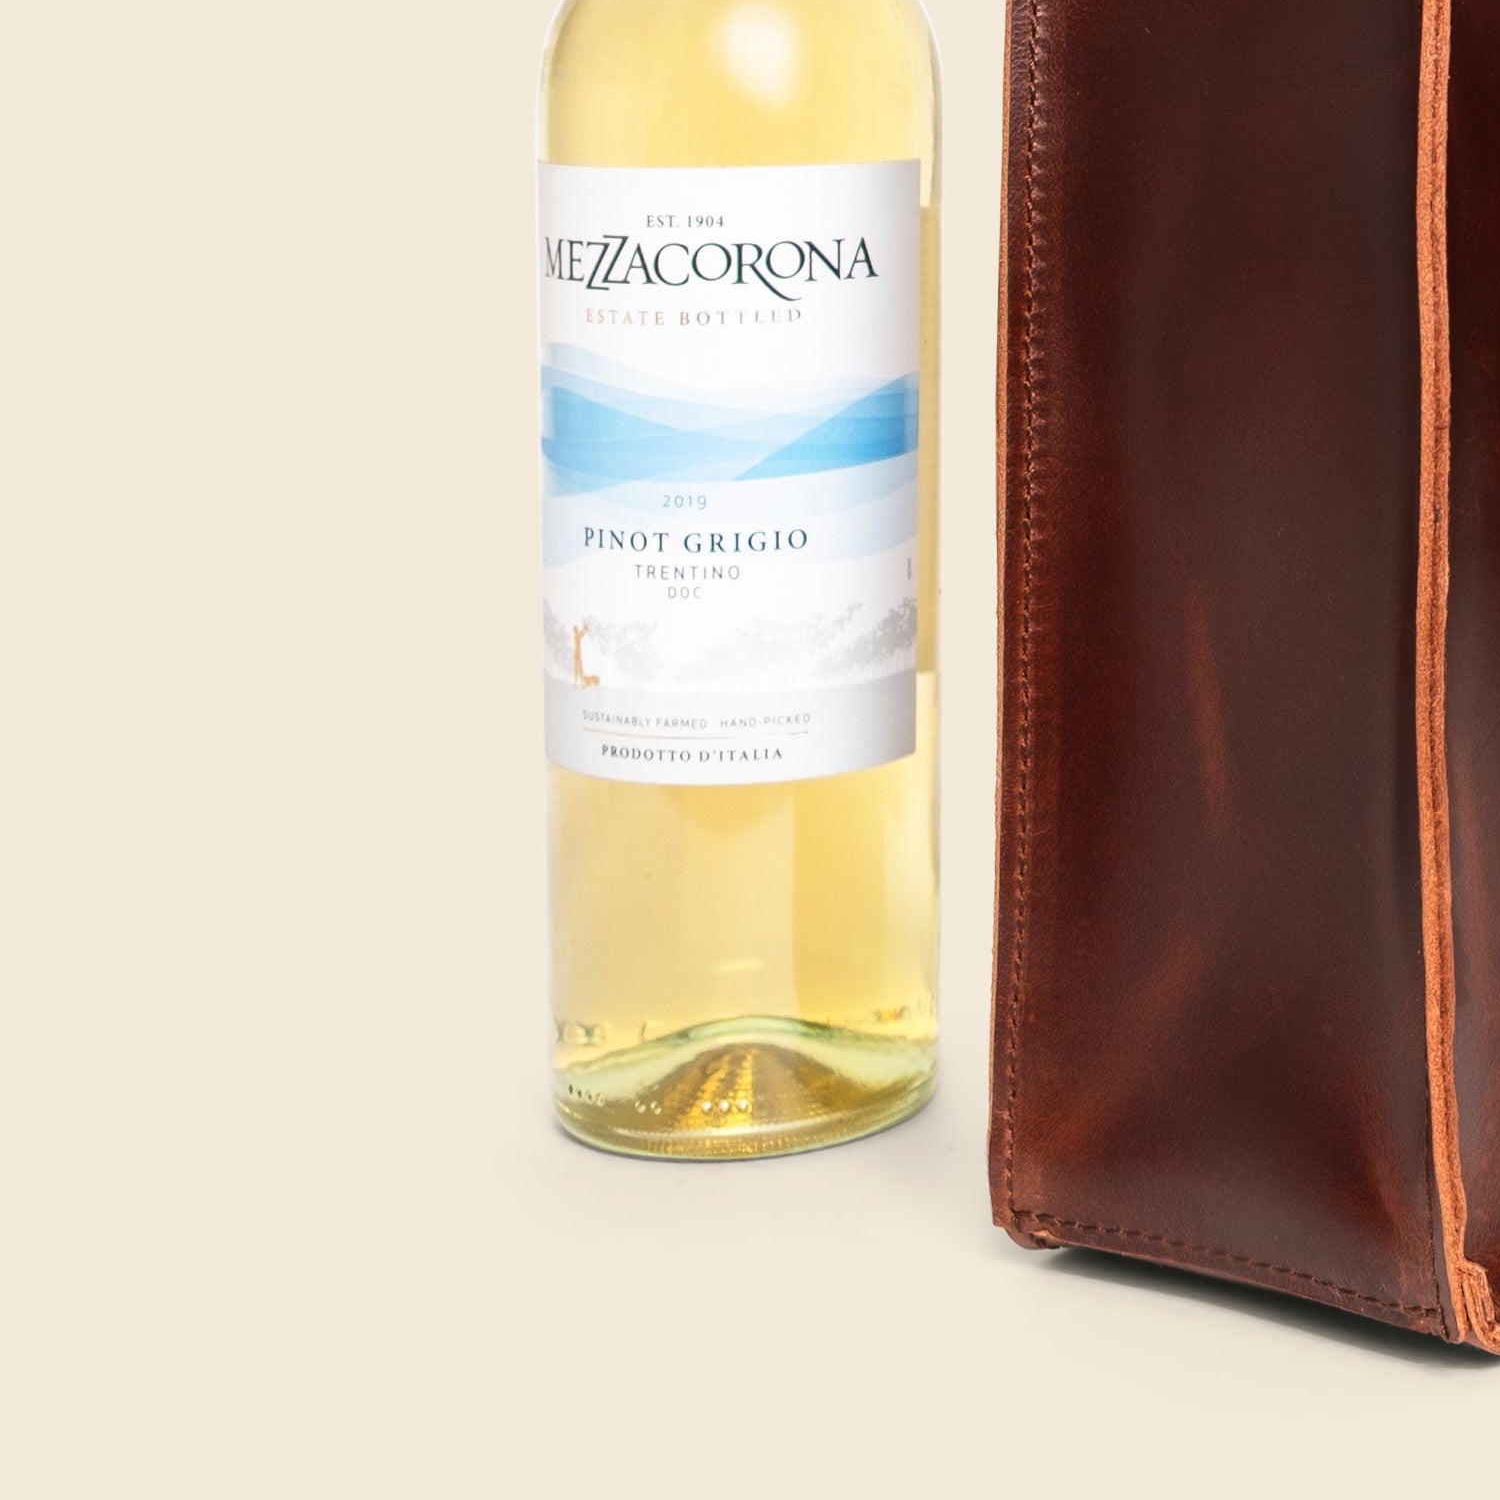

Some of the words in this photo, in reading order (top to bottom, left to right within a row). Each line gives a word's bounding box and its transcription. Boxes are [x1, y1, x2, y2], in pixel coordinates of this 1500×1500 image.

[646, 214, 680, 228] EST.
[686, 215, 724, 229] 1904
[544, 235, 879, 302] MEZZACORONA
[585, 308, 664, 327] ESTATE
[662, 495, 708, 511] 2019
[584, 527, 670, 553] PINOT
[683, 528, 808, 554] GRIGIO
[634, 564, 741, 581] TRENTINO
[667, 586, 702, 601] DOC
[582, 709, 651, 728] SUSTAINABLY
[656, 717, 708, 730] FARMED
[601, 744, 692, 763] PRODOTTO
[699, 747, 784, 763] D'ITALIA
